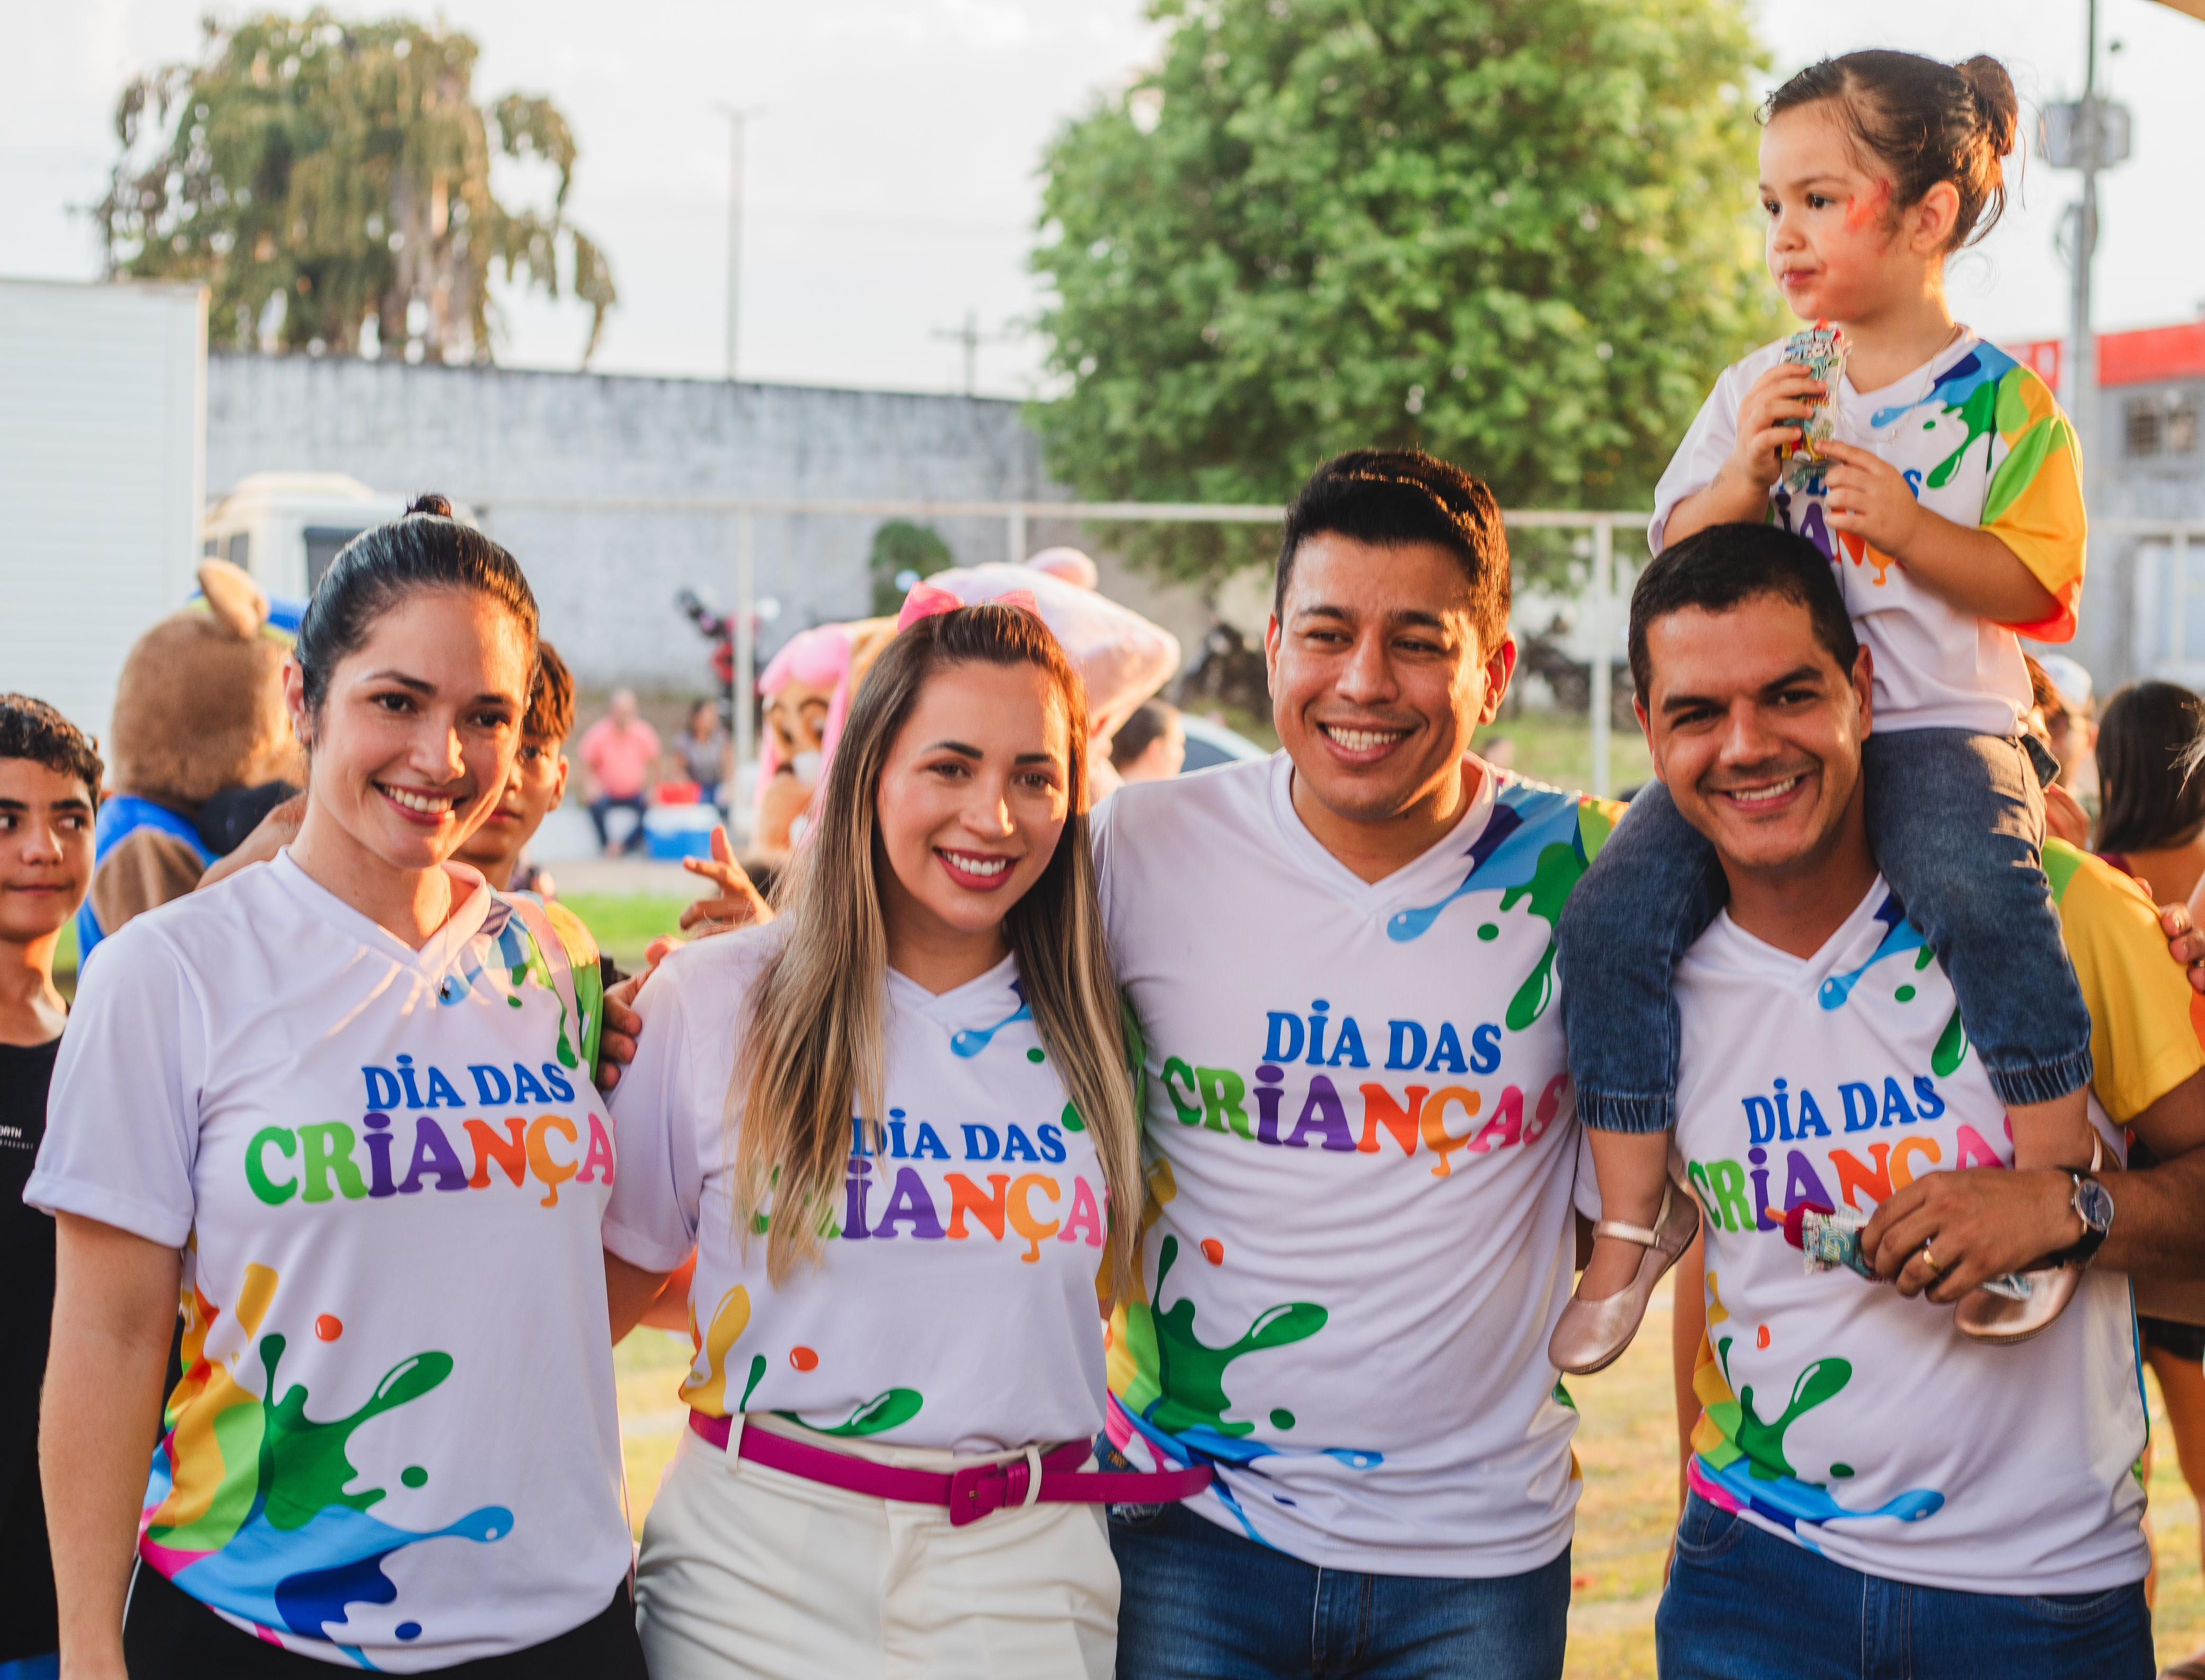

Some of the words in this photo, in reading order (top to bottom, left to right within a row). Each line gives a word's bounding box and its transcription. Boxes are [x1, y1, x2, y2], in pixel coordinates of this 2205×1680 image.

[1384, 1021, 1502, 1075] DAS
[468, 1062, 576, 1107] DAS
[1838, 1076, 1946, 1134] DAS
[245, 1112, 616, 1208] CRIANÇA
[960, 1124, 1068, 1163] DAS
